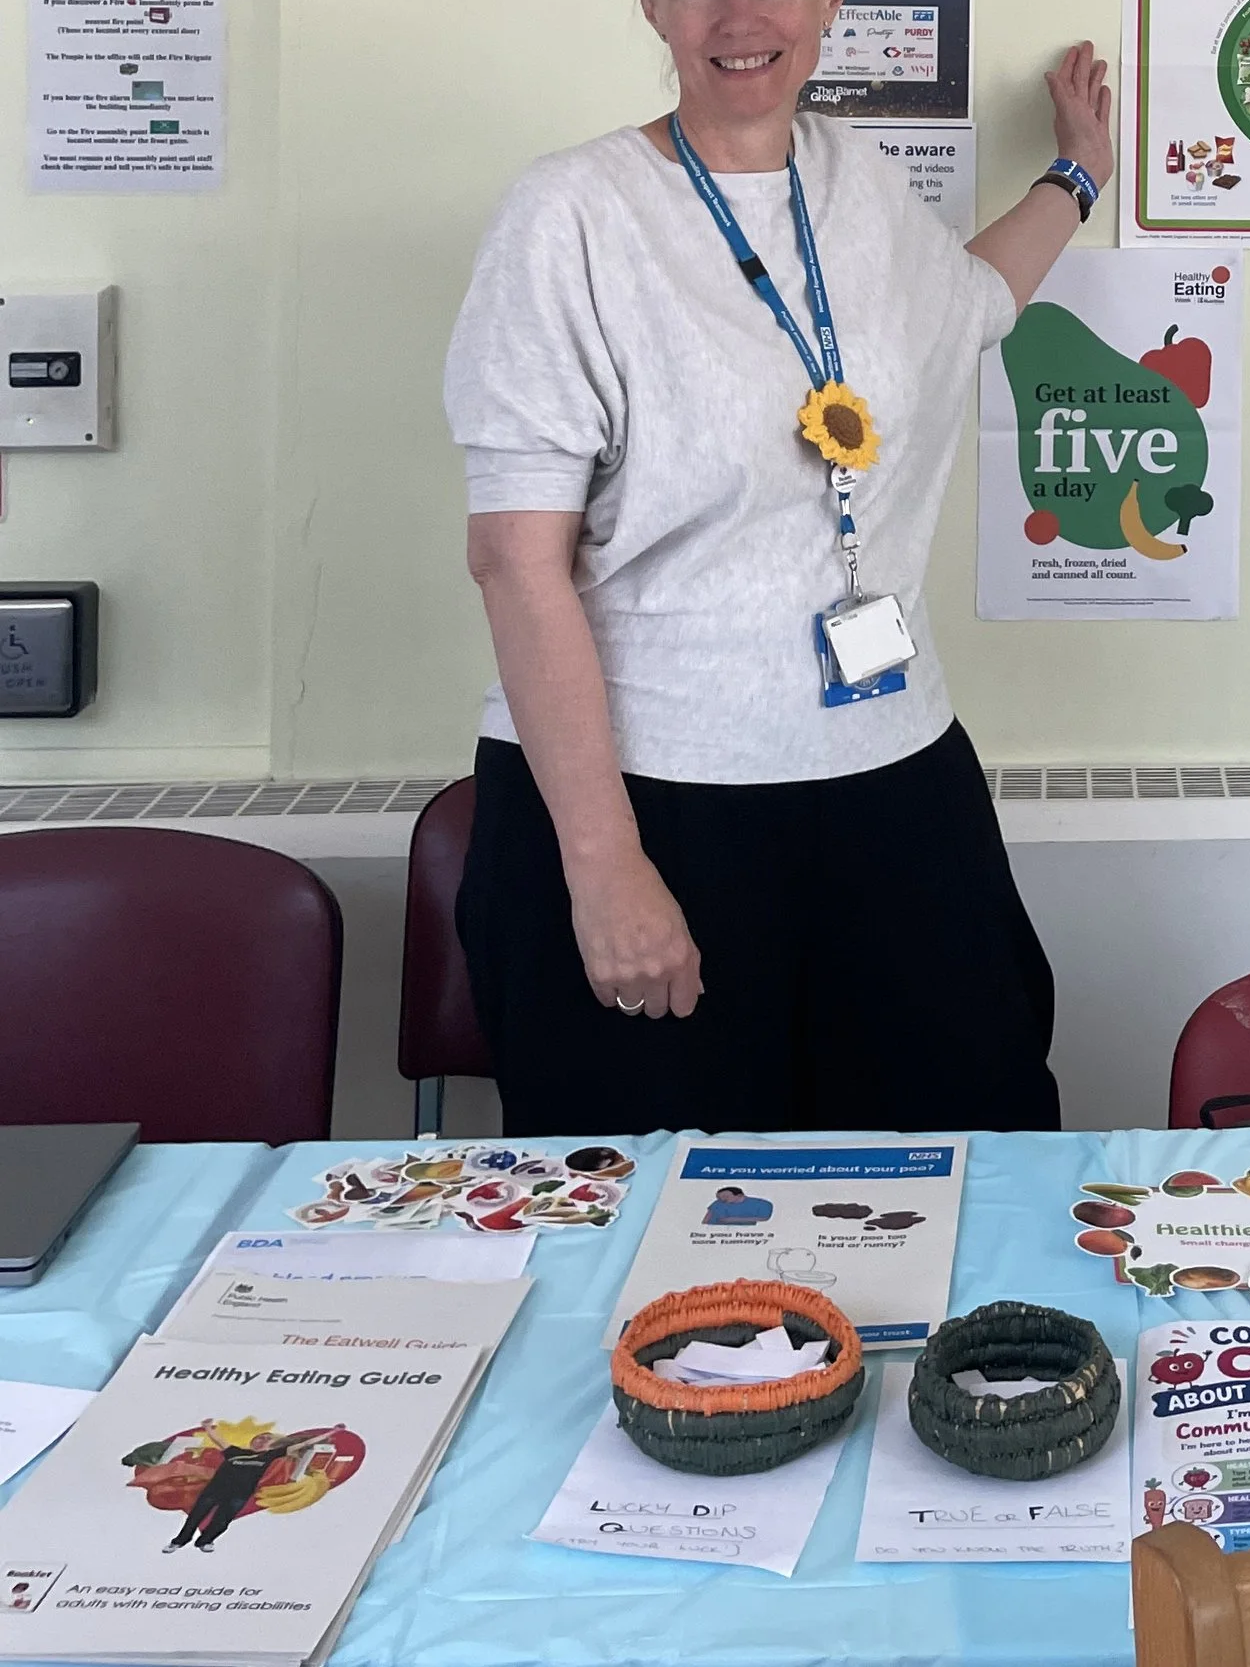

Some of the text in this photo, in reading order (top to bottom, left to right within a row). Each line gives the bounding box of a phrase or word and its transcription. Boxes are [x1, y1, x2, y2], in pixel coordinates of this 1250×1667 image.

[839, 9, 902, 20] EffectAble
[905, 28, 934, 36] PURDY
[816, 86, 867, 96] The Barnet
[810, 92, 841, 105] Group
[905, 145, 955, 156] aware
[907, 163, 955, 173] nd videos
[926, 178, 943, 188] this
[924, 193, 941, 202] and
[1174, 272, 1210, 282] Healthy
[1174, 282, 1224, 298] Eating
[822, 328, 833, 348] NHS
[1035, 383, 1171, 404] Get at least
[1034, 407, 1178, 474] five
[1033, 477, 1098, 502] a day
[1032, 558, 1126, 568] Fresh, frozen, dried
[1032, 570, 1136, 579] and canned all count.
[701, 1164, 935, 1175] Are you worried about your poo?
[237, 1239, 283, 1248] BDA
[282, 1334, 318, 1346] The
[324, 1336, 400, 1349] Eatwell
[154, 1363, 442, 1388] Healthy Eating Guide
[1168, 1384, 1247, 1411] ABOUT
[1199, 1441, 1222, 1449] here
[1203, 1447, 1233, 1457] about
[590, 1500, 737, 1517] LUCKY DIP
[909, 1505, 987, 1523] TRUE
[1029, 1503, 1111, 1520] FALSE
[599, 1522, 757, 1539] QUESTIONS
[66, 1584, 263, 1598] An easy read guide for
[56, 1599, 312, 1612] adults with learning disabilities
